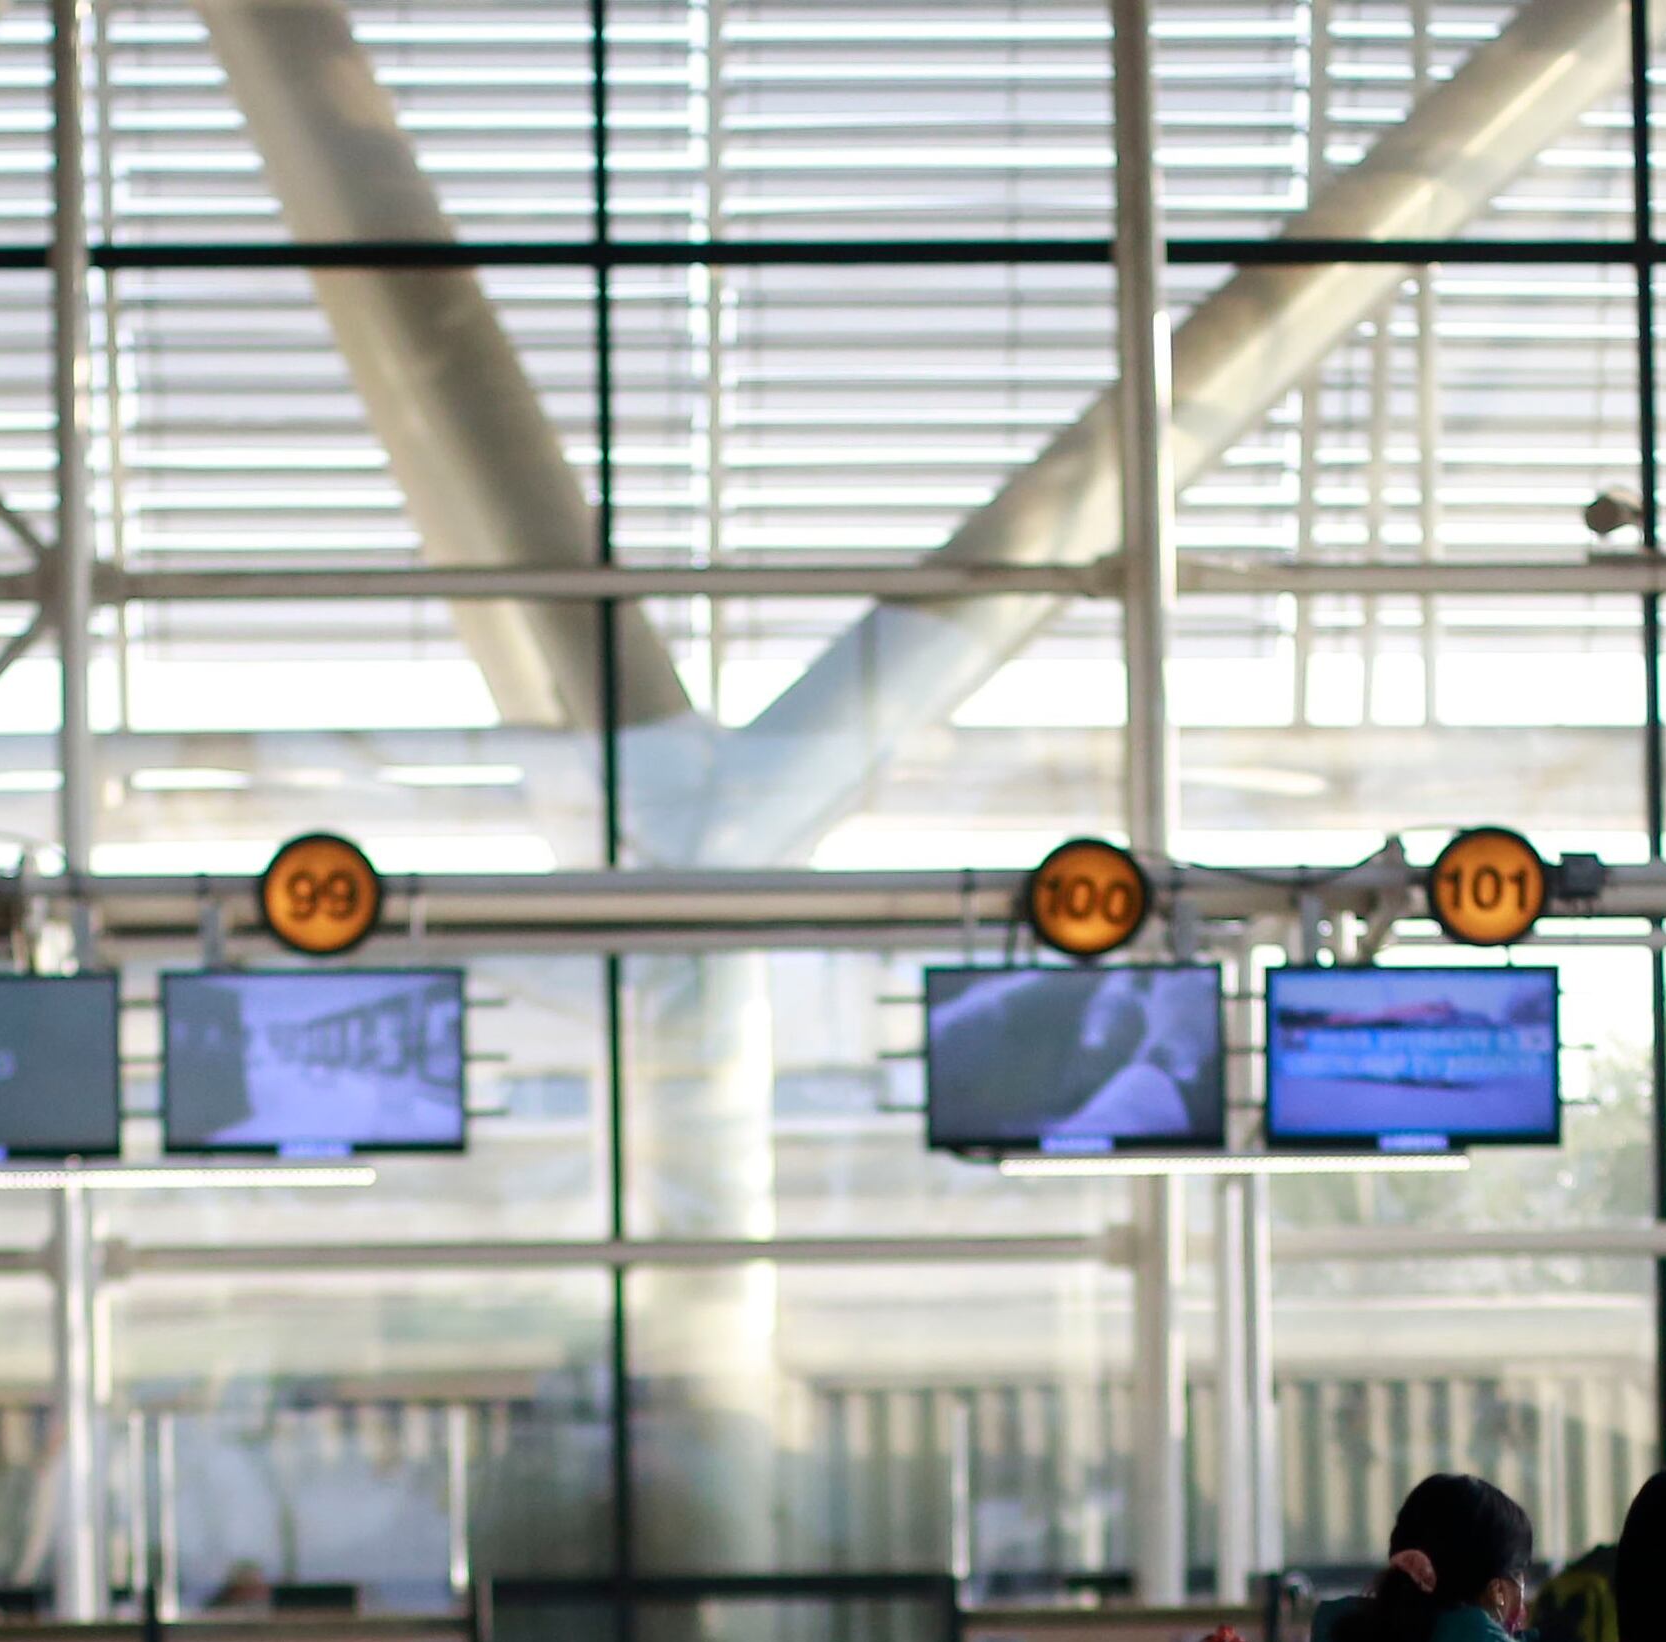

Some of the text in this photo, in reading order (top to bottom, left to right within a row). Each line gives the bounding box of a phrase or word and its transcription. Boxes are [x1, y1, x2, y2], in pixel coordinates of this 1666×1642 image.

[286, 867, 359, 922] 99
[1042, 873, 1136, 926] 100
[1444, 864, 1530, 912] 101
